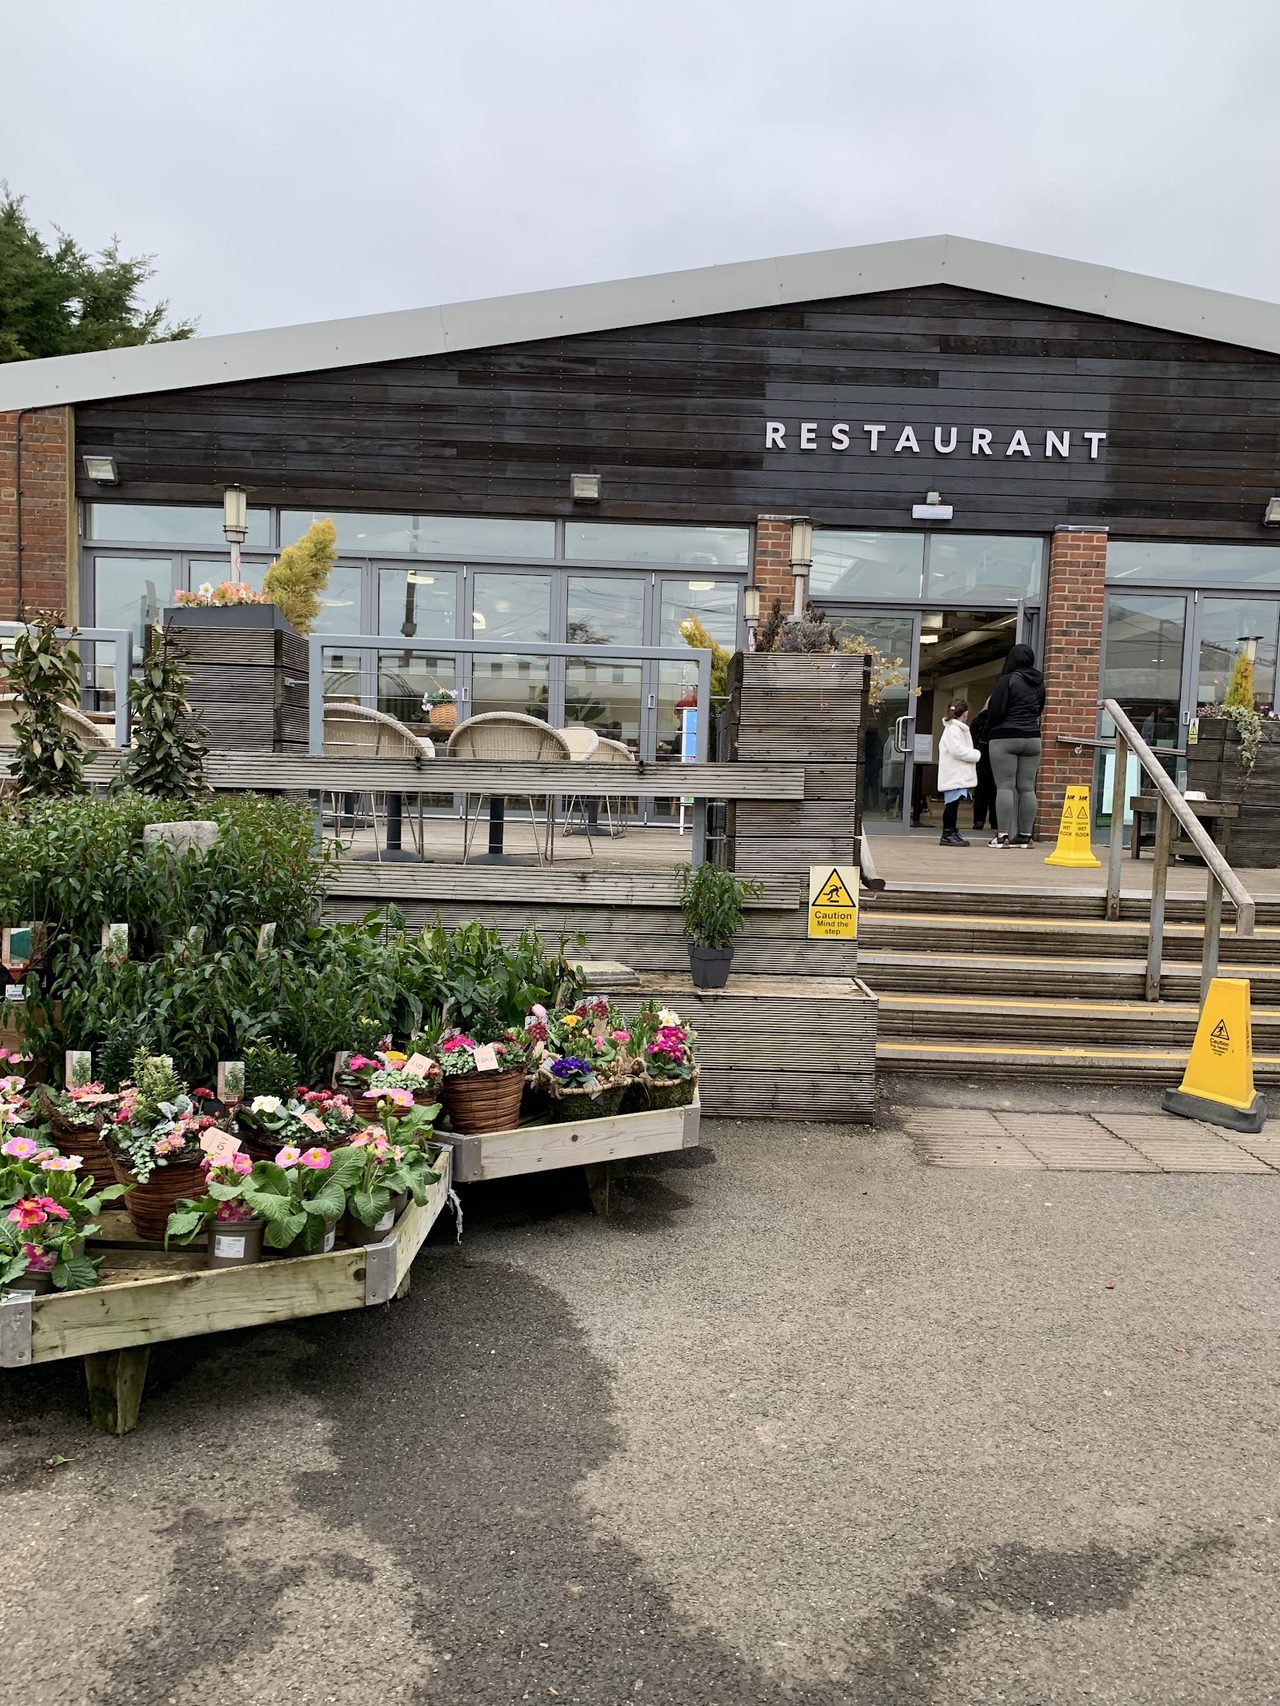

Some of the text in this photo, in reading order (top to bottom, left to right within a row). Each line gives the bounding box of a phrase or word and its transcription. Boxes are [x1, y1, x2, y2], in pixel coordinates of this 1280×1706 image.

[765, 421, 1107, 459] RESTAURANT
[814, 910, 853, 920] Caution
[816, 920, 836, 928] Mind
[824, 928, 841, 936] step
[1210, 1037, 1230, 1048] Caution
